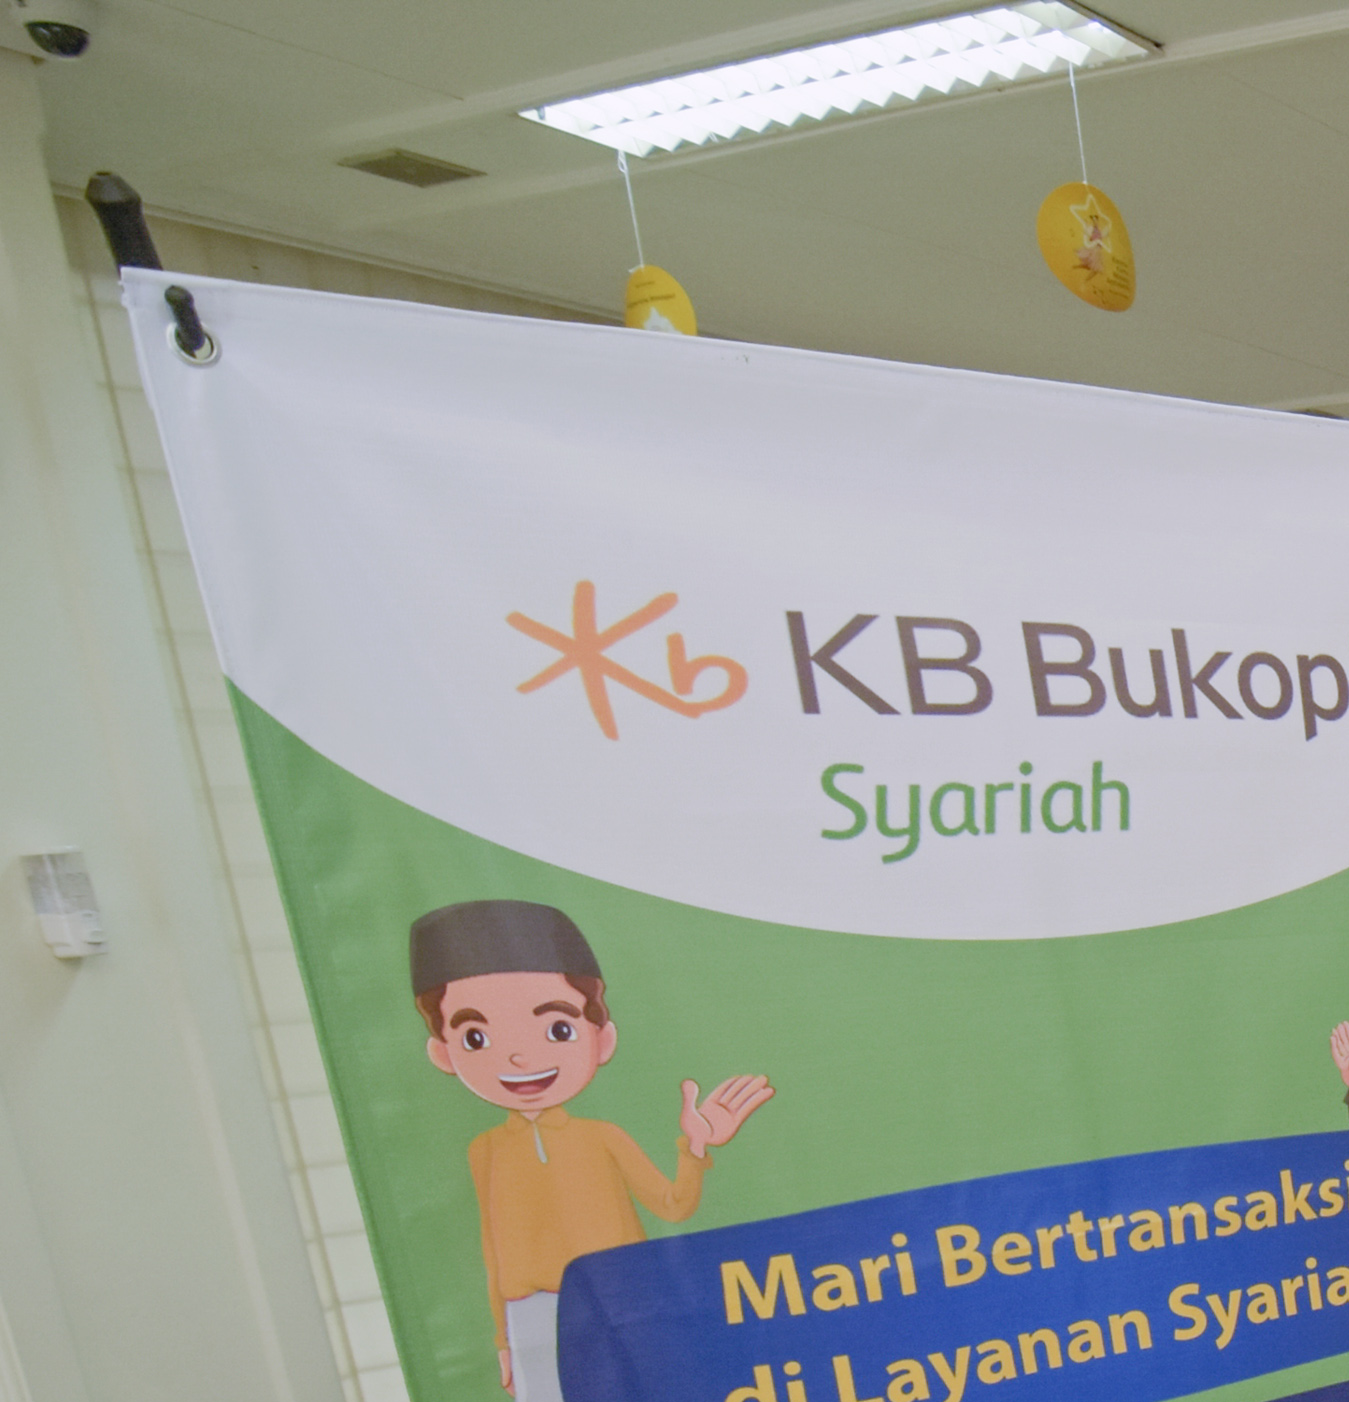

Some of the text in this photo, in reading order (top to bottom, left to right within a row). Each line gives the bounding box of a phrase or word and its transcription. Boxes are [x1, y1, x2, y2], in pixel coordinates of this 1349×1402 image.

[784, 609, 994, 717] KB
[819, 760, 1132, 864] Syariah
[721, 1232, 918, 1326] Mari
